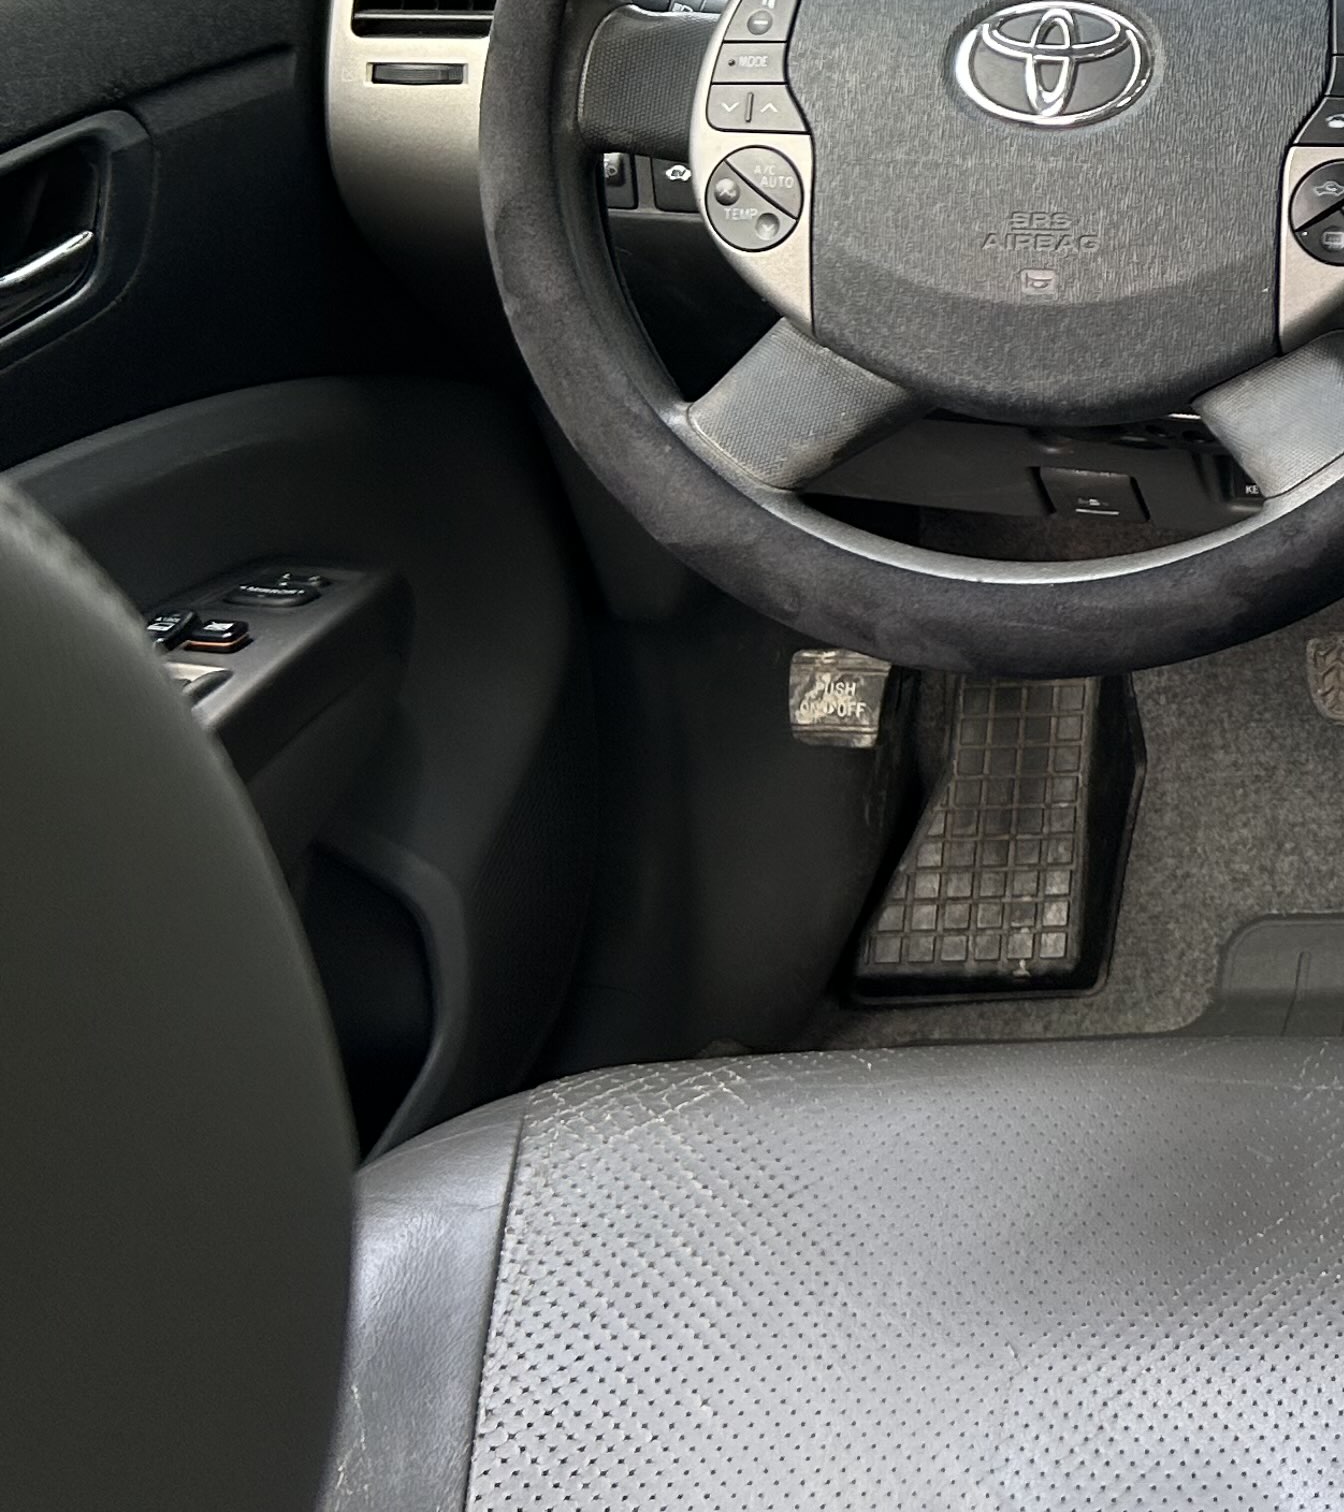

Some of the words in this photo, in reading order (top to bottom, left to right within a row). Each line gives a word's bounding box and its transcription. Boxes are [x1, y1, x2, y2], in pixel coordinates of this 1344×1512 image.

[737, 54, 769, 68] MODE
[753, 164, 777, 177] A/C
[760, 175, 795, 189] AUTO
[724, 206, 759, 221] TEMP
[1010, 210, 1073, 230] SRS
[981, 232, 1101, 252] AIRBAG
[815, 681, 857, 697] PUSH
[837, 701, 867, 719] OFF
